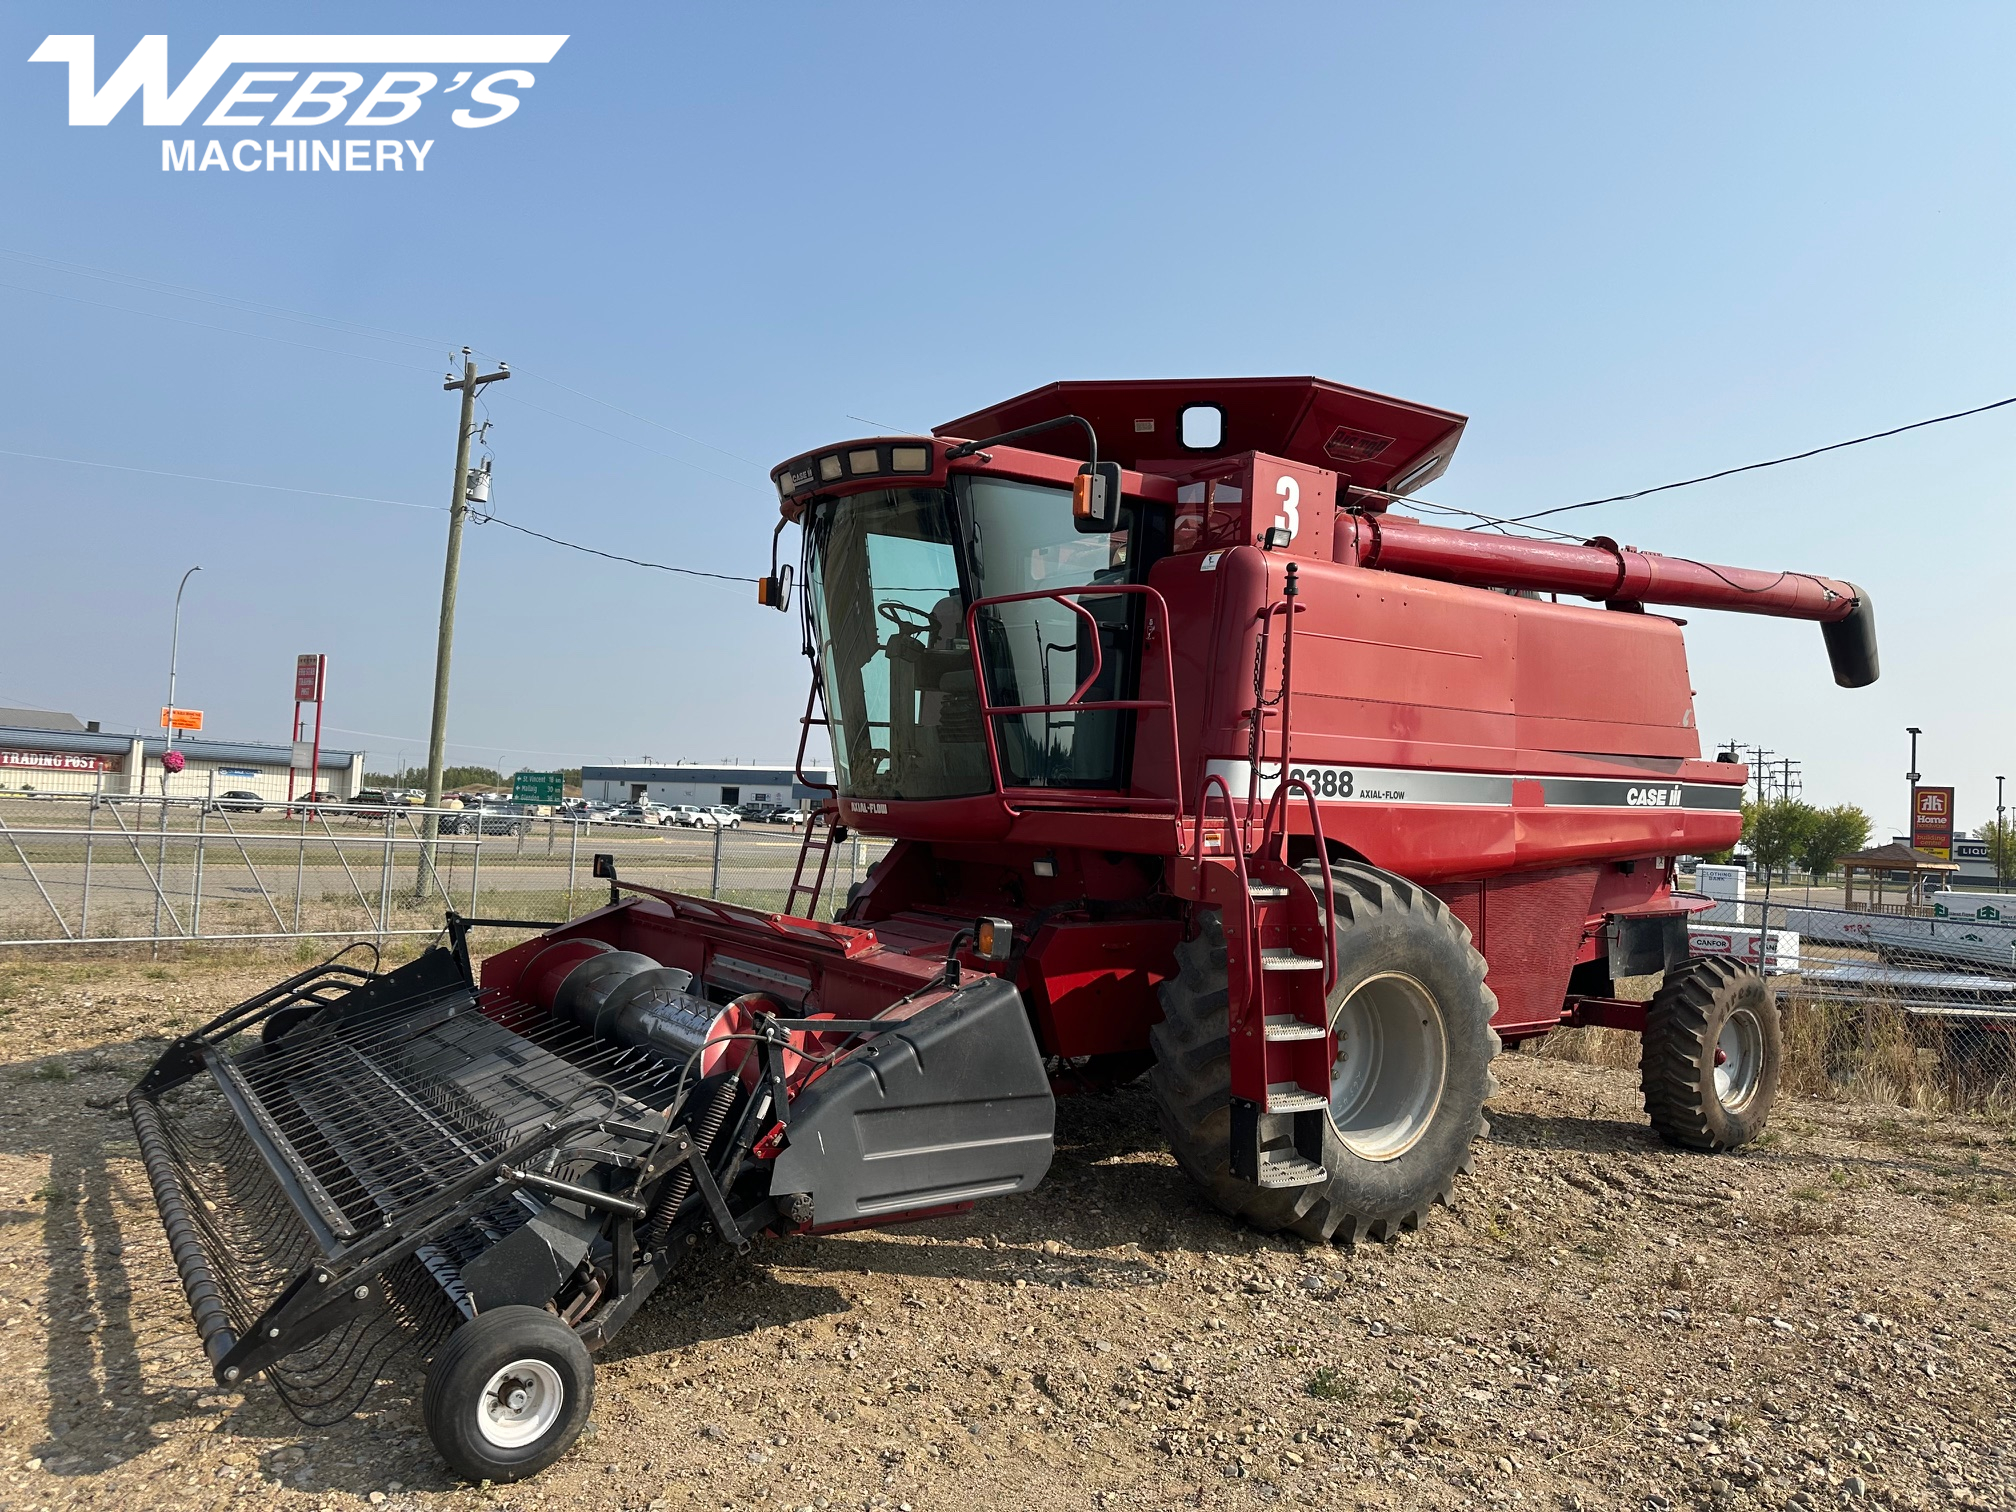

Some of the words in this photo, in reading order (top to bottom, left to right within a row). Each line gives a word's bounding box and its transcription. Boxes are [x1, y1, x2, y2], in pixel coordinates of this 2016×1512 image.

[792, 470, 807, 482] CASE
[1274, 475, 1300, 540] 3
[1, 751, 63, 768] TRADING
[64, 755, 96, 769] POST
[521, 785, 538, 794] Mallaig
[1288, 768, 1354, 798] 2388
[1359, 789, 1405, 800] AXIAL-FLOW
[1626, 787, 1667, 806] CASE
[850, 802, 888, 814] AXIAL-FLOW
[1916, 815, 1948, 824] Home
[1916, 834, 1946, 842] building
[1702, 870, 1732, 878] CLOTHING
[1696, 939, 1728, 948] CANFOR
